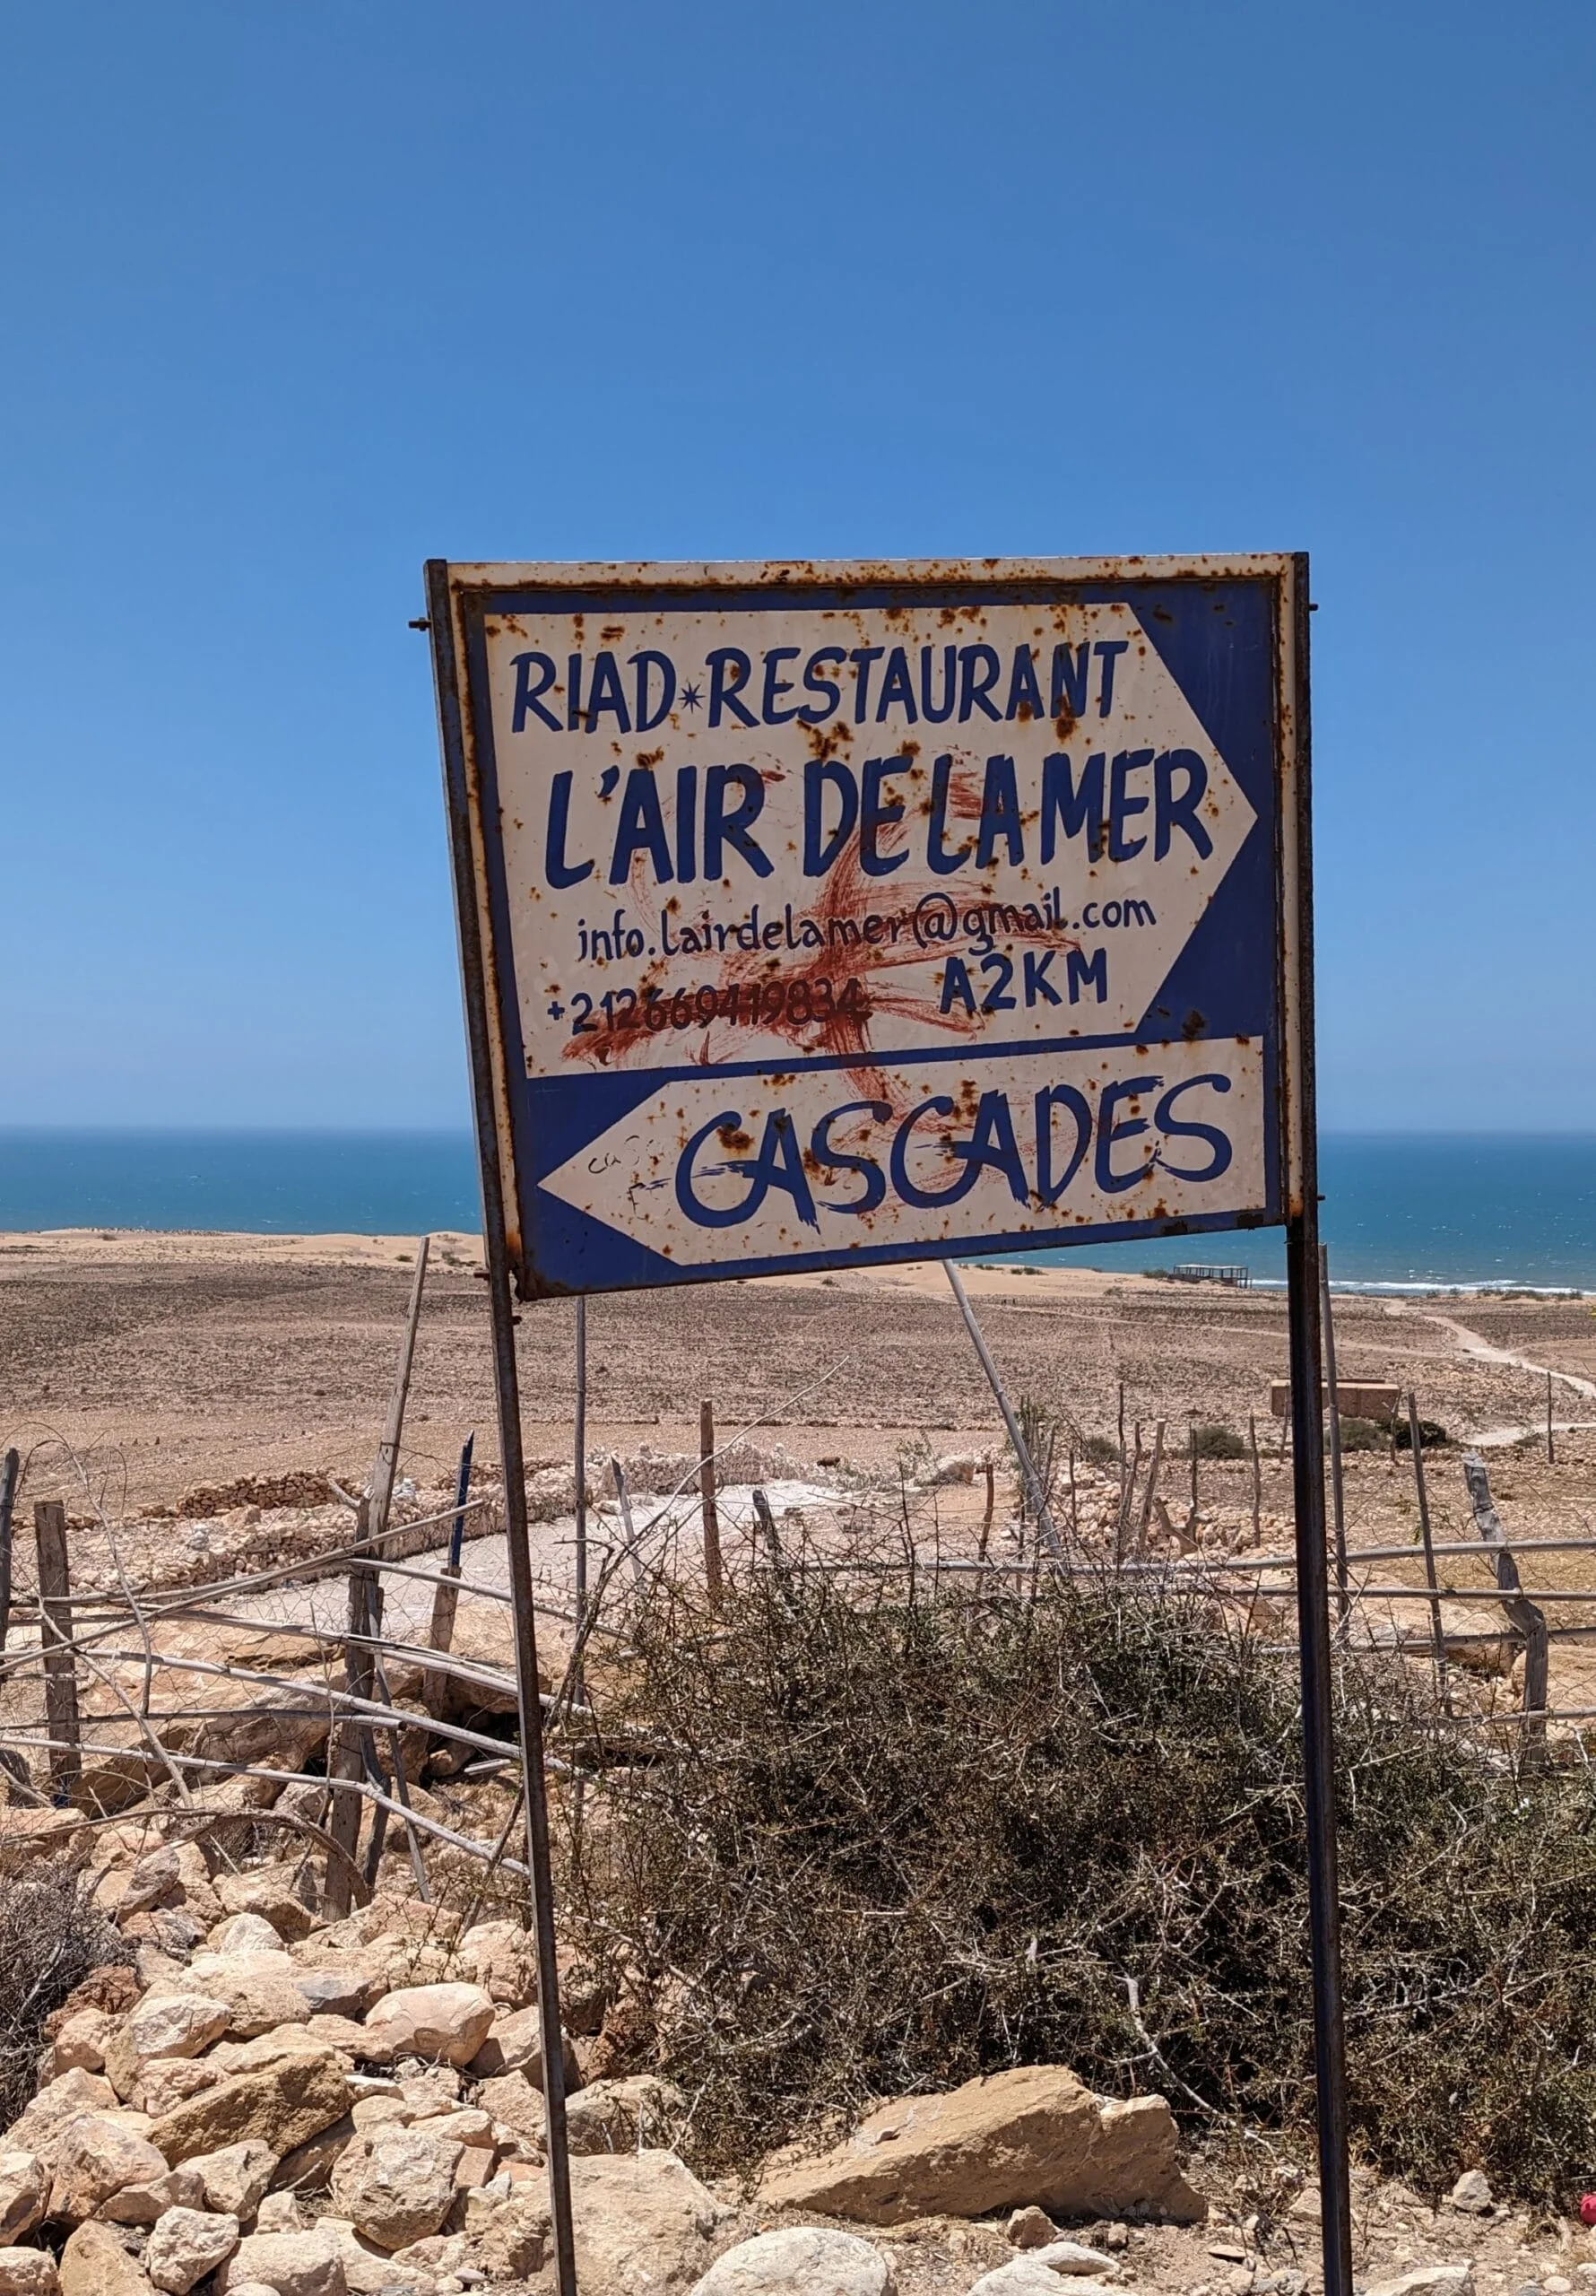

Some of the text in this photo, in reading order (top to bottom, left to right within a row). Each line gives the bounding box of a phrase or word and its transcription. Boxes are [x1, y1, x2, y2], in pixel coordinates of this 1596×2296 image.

[509, 640, 1131, 734] RIAD RESTAURANT
[545, 748, 1215, 891] L'AIR DE LA MER
[577, 886, 1158, 957] info.lairdelamer@gmail.com
[674, 1074, 1234, 1234] CASCADES
